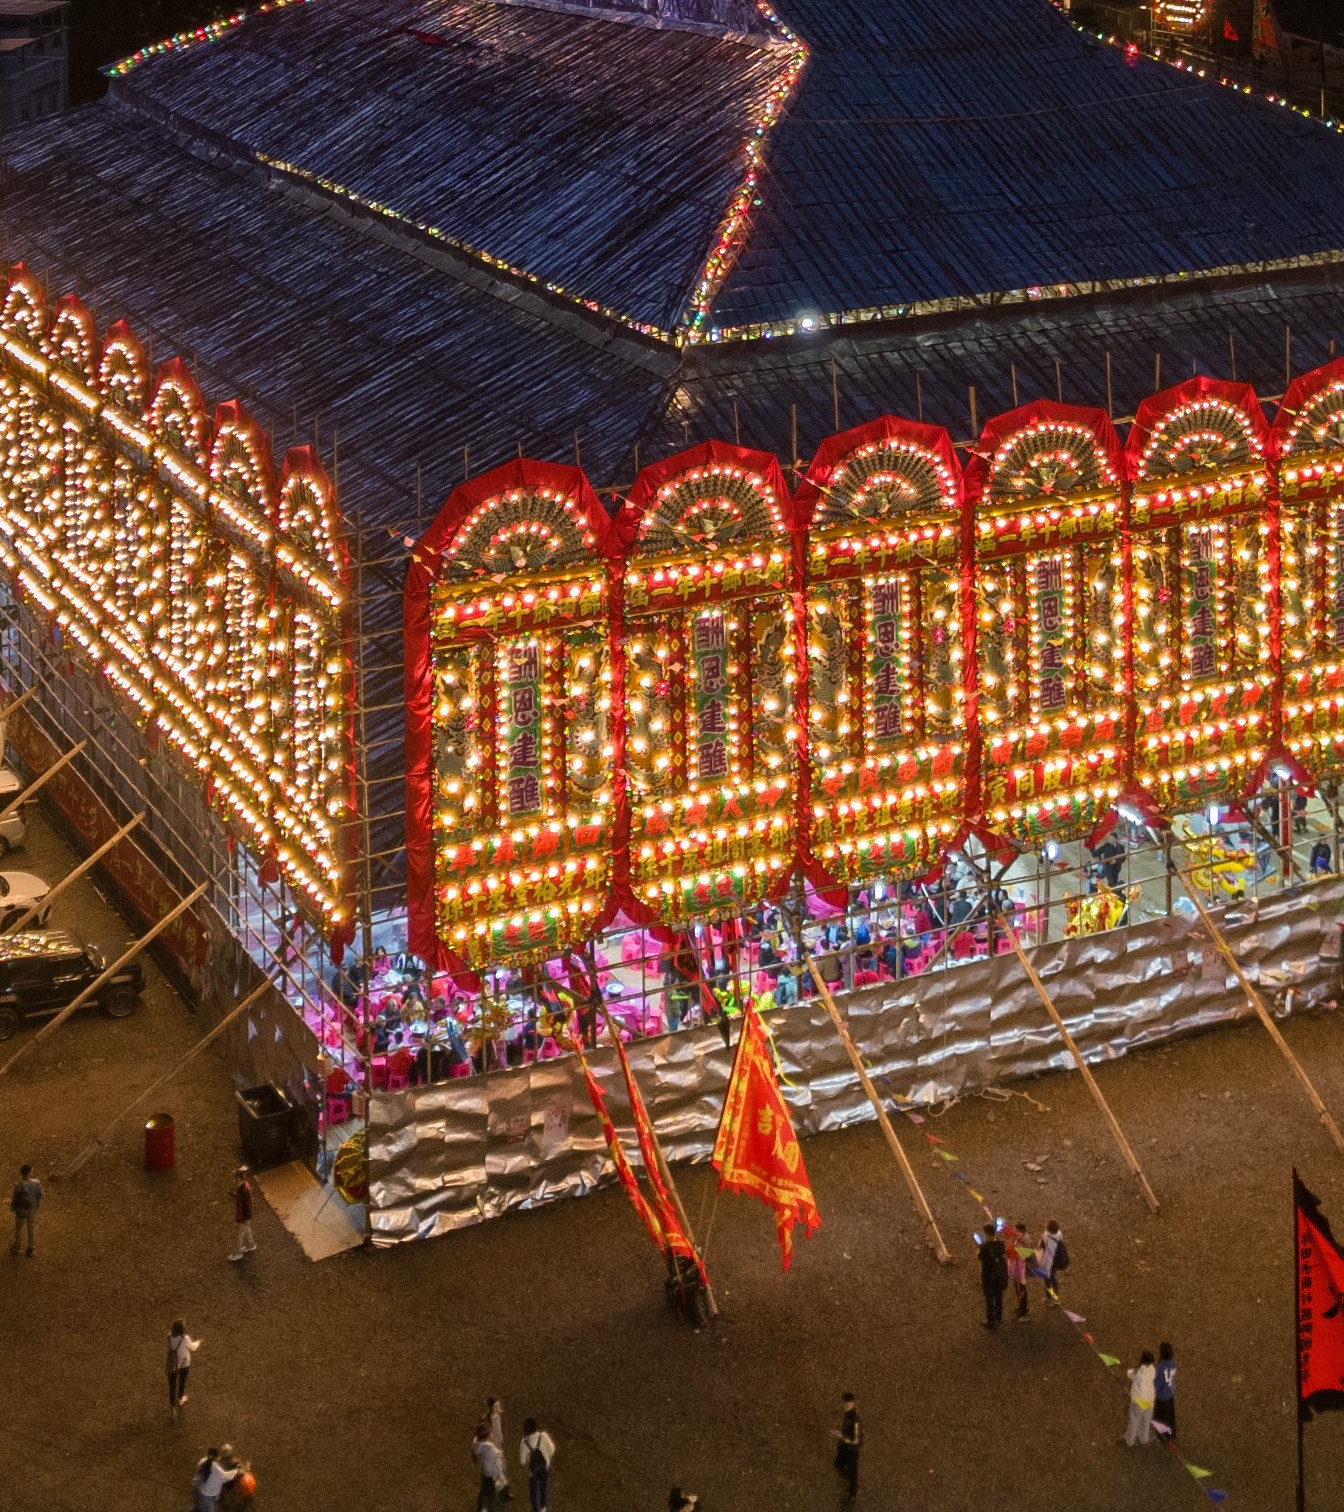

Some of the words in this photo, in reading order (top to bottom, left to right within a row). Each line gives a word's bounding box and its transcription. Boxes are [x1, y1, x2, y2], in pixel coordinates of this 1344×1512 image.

[693, 612, 729, 779] 酬恩建醮
[871, 577, 904, 741] 酬恩建醮
